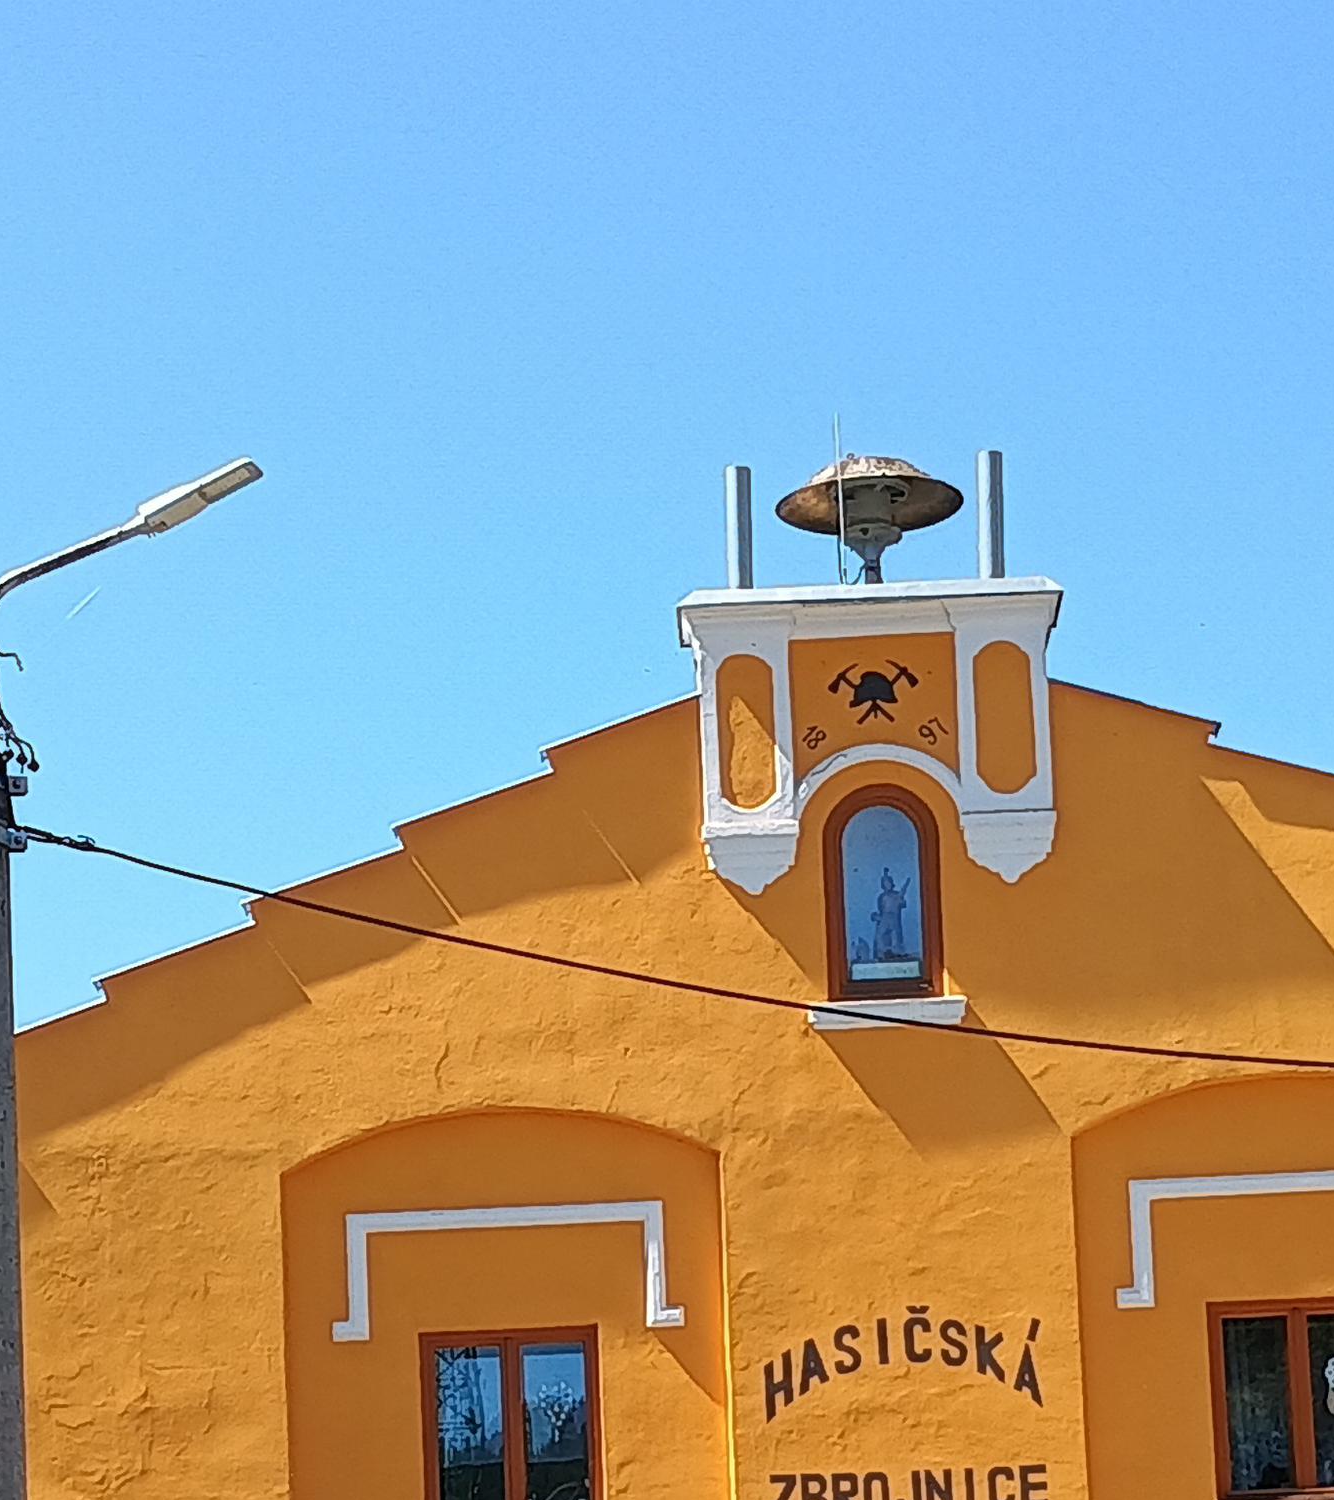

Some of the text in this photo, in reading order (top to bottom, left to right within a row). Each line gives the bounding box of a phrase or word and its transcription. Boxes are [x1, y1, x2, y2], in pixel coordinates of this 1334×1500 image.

[802, 717, 949, 750] 18 97
[763, 1304, 1044, 1425] HASIČSKÁ
